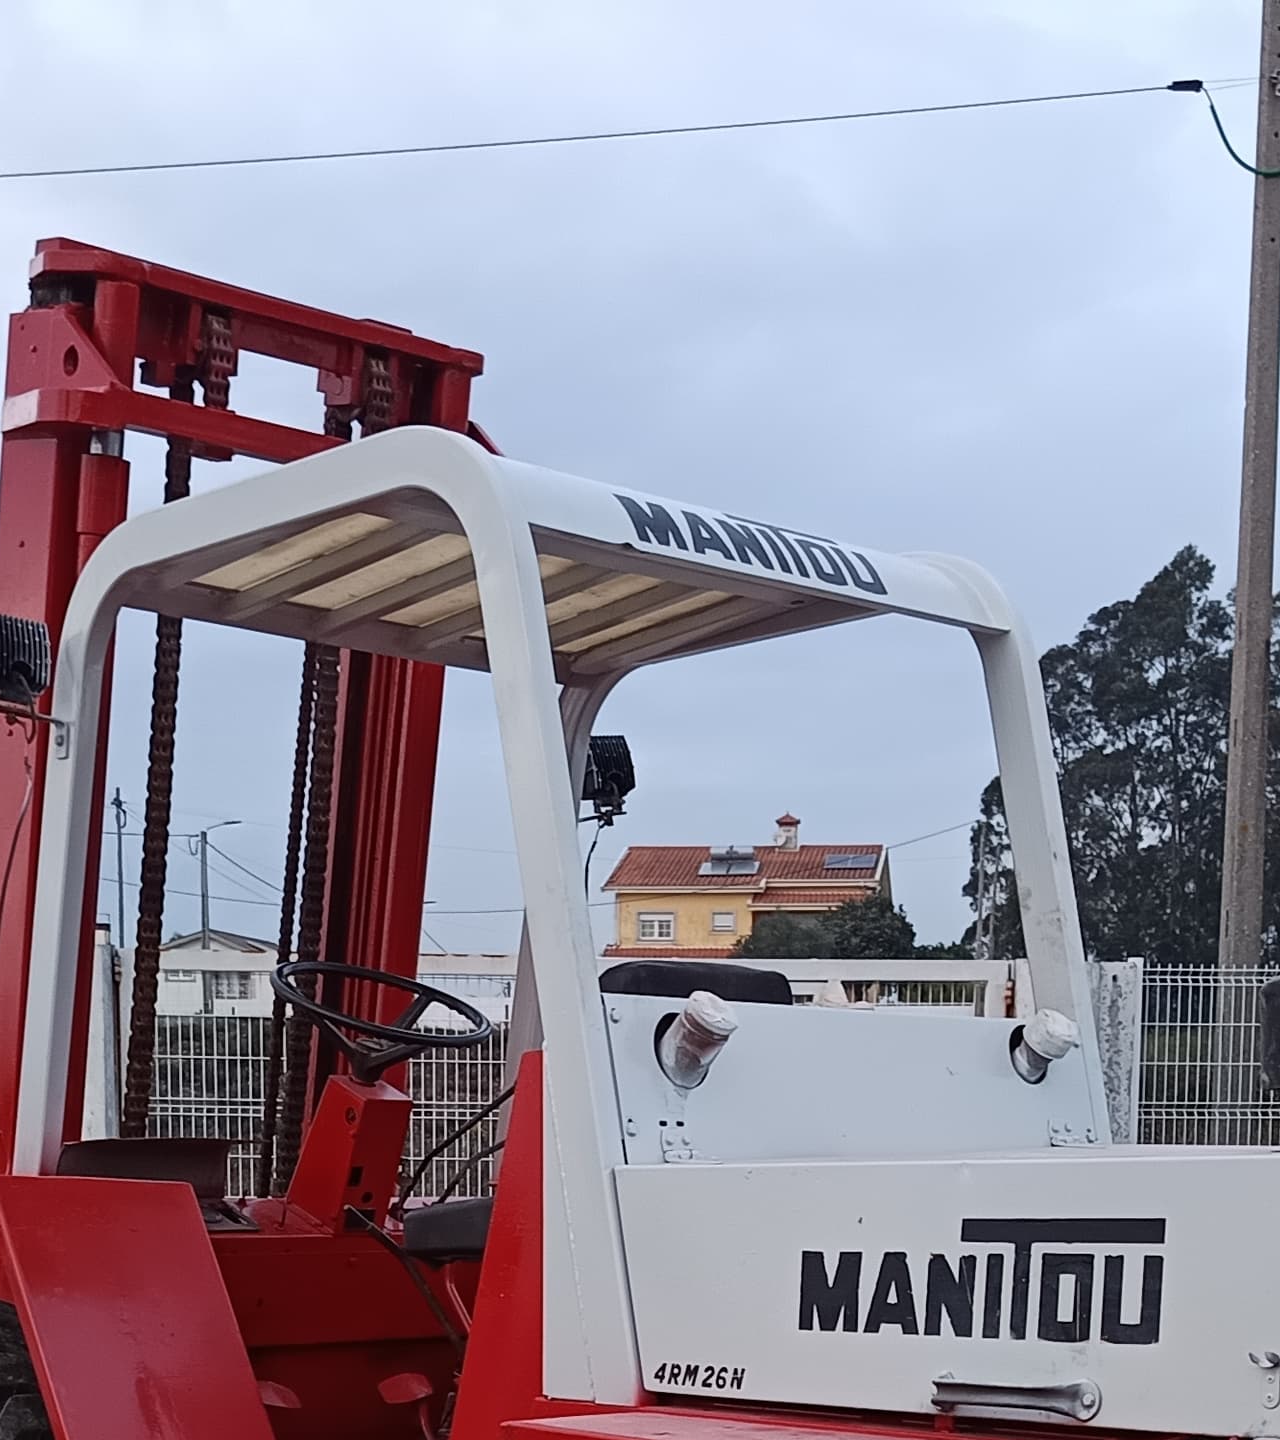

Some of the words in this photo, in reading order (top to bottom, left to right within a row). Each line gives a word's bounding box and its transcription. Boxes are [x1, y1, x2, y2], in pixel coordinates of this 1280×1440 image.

[612, 493, 888, 595] MANITOU
[798, 1217, 1166, 1345] MANITOU
[653, 1362, 746, 1390] 4RM26N
